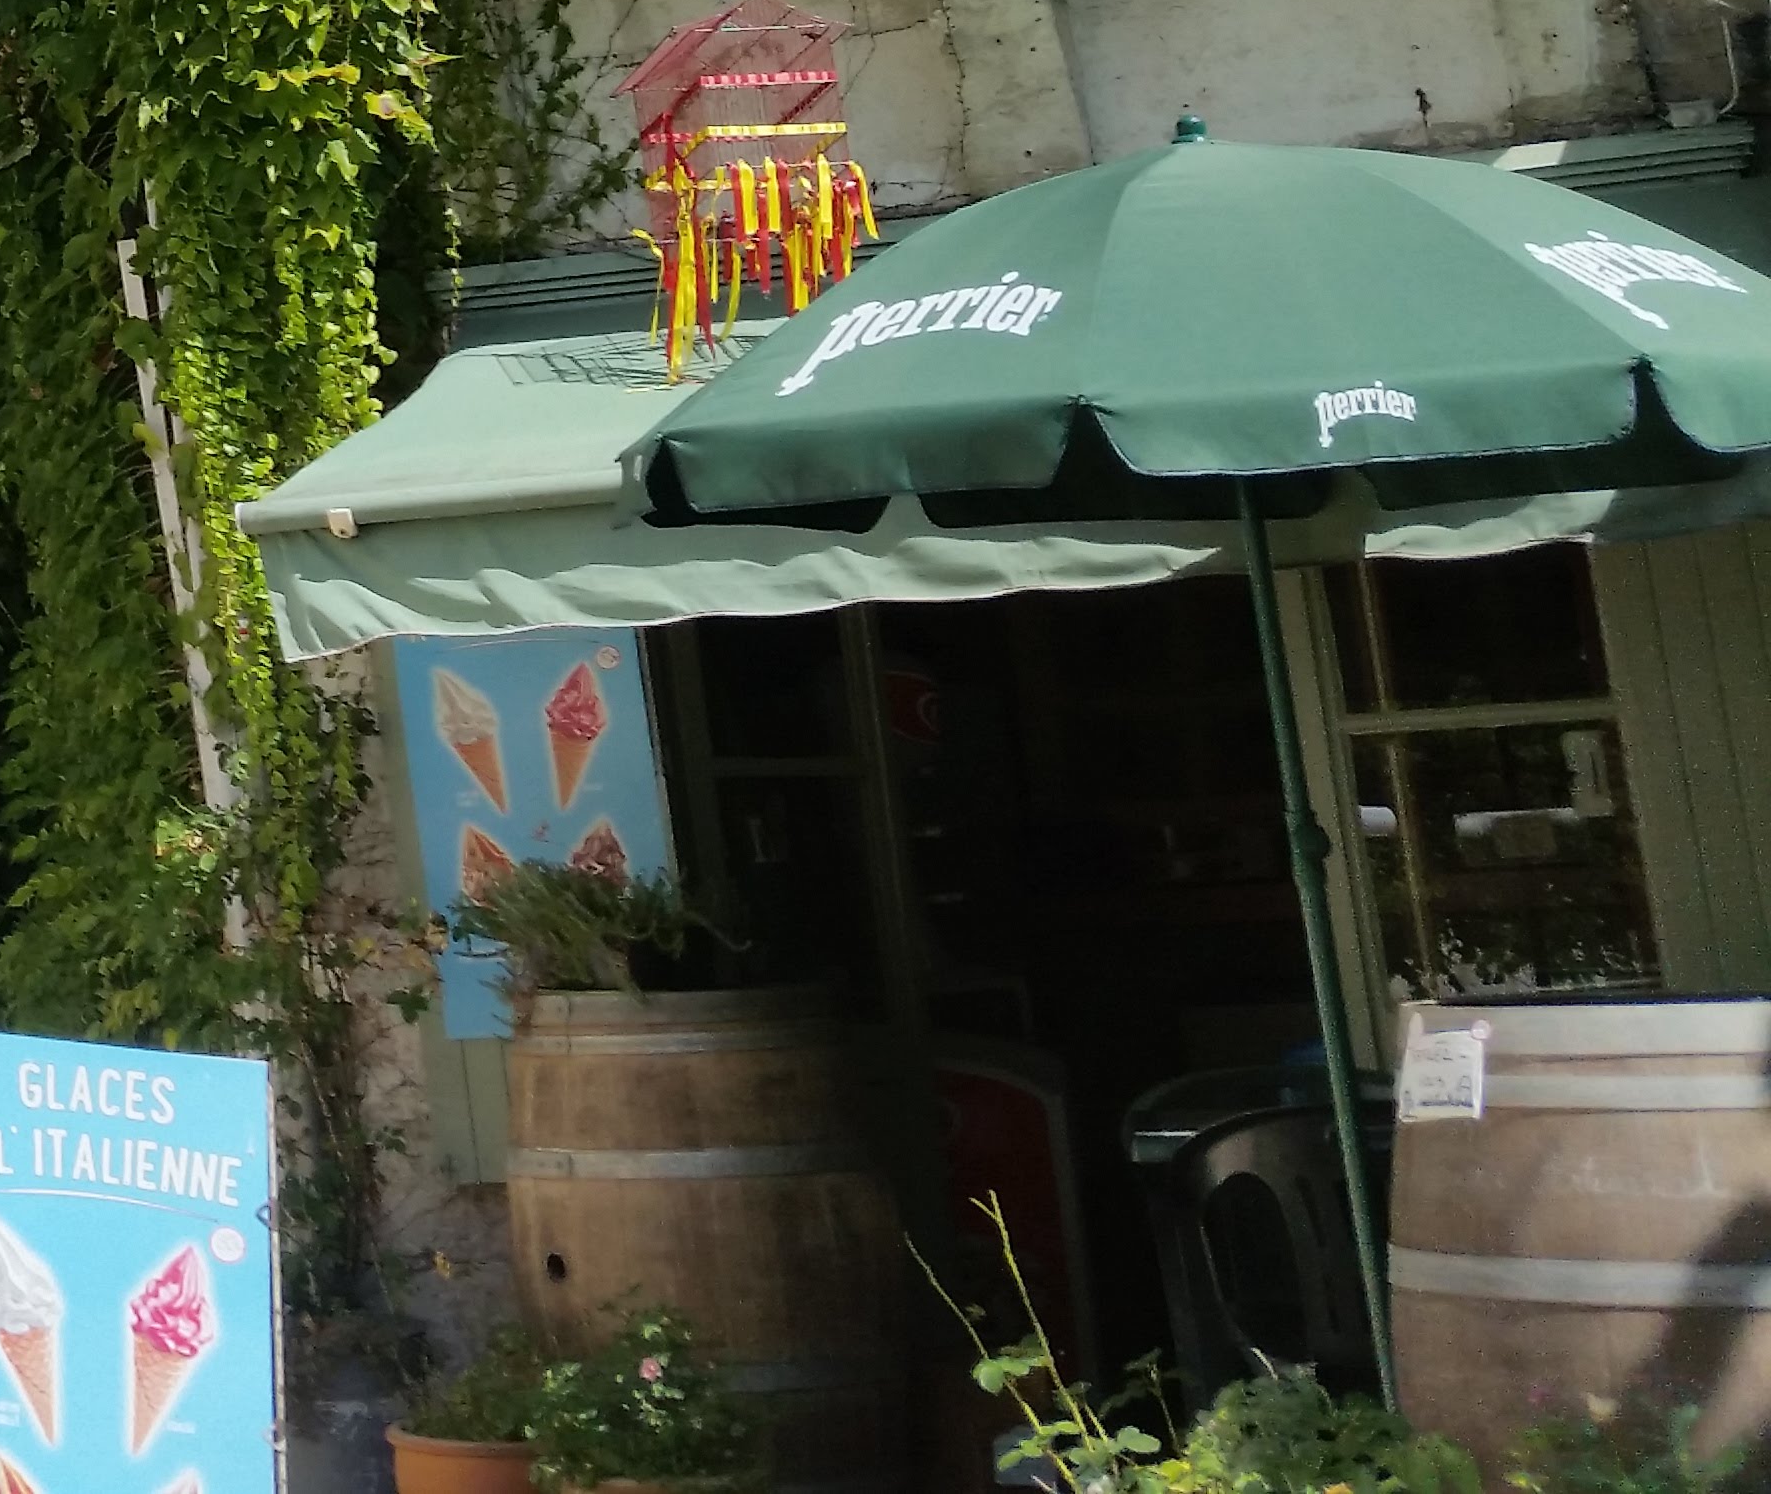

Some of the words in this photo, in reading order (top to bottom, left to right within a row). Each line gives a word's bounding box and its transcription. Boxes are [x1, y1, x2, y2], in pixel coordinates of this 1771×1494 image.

[774, 269, 1063, 397] perrier
[1313, 379, 1418, 448] perrier
[17, 1060, 177, 1126] GLACES
